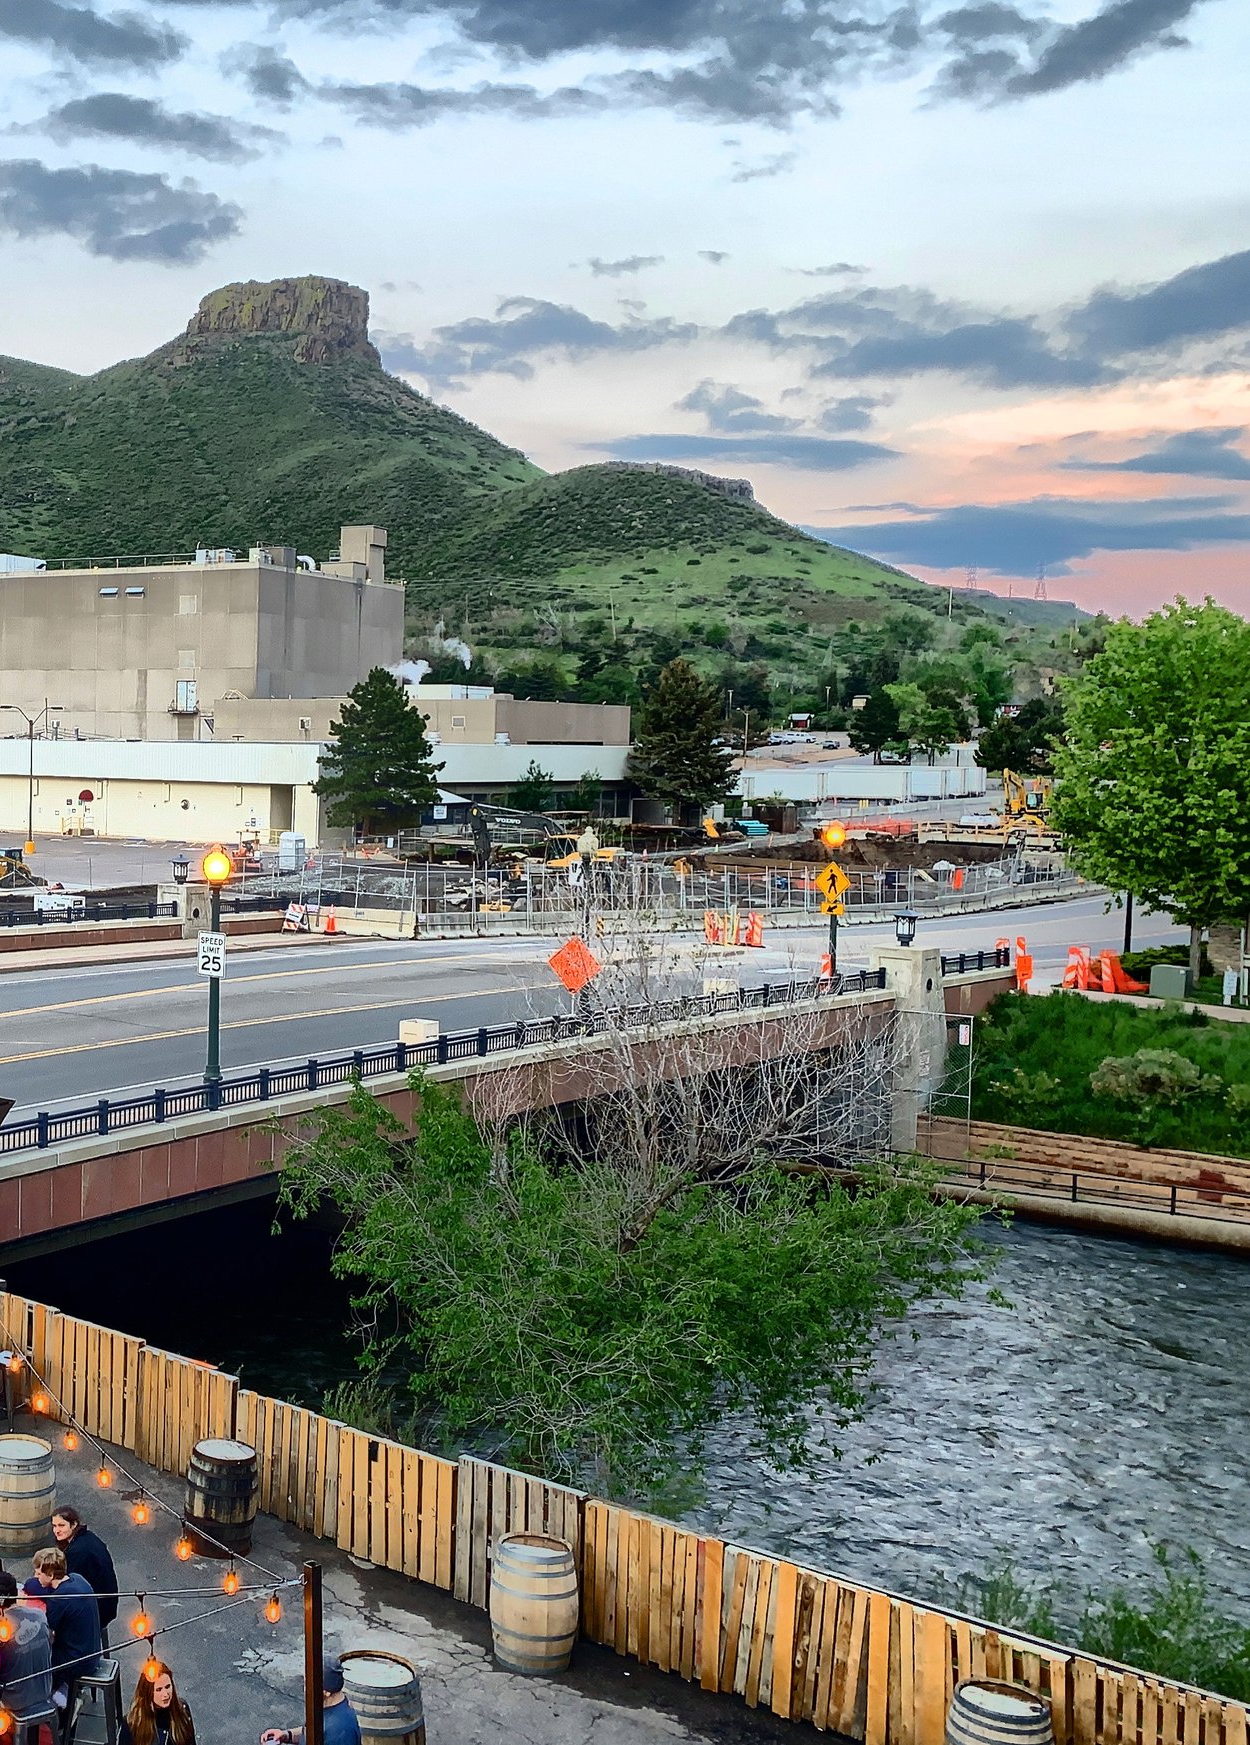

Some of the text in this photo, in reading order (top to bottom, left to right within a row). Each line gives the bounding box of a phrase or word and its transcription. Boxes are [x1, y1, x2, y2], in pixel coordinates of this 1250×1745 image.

[495, 817, 521, 825] VOLVO
[201, 936, 224, 946] SPEED
[202, 946, 220, 954] LIMIT
[201, 955, 221, 972] 25
